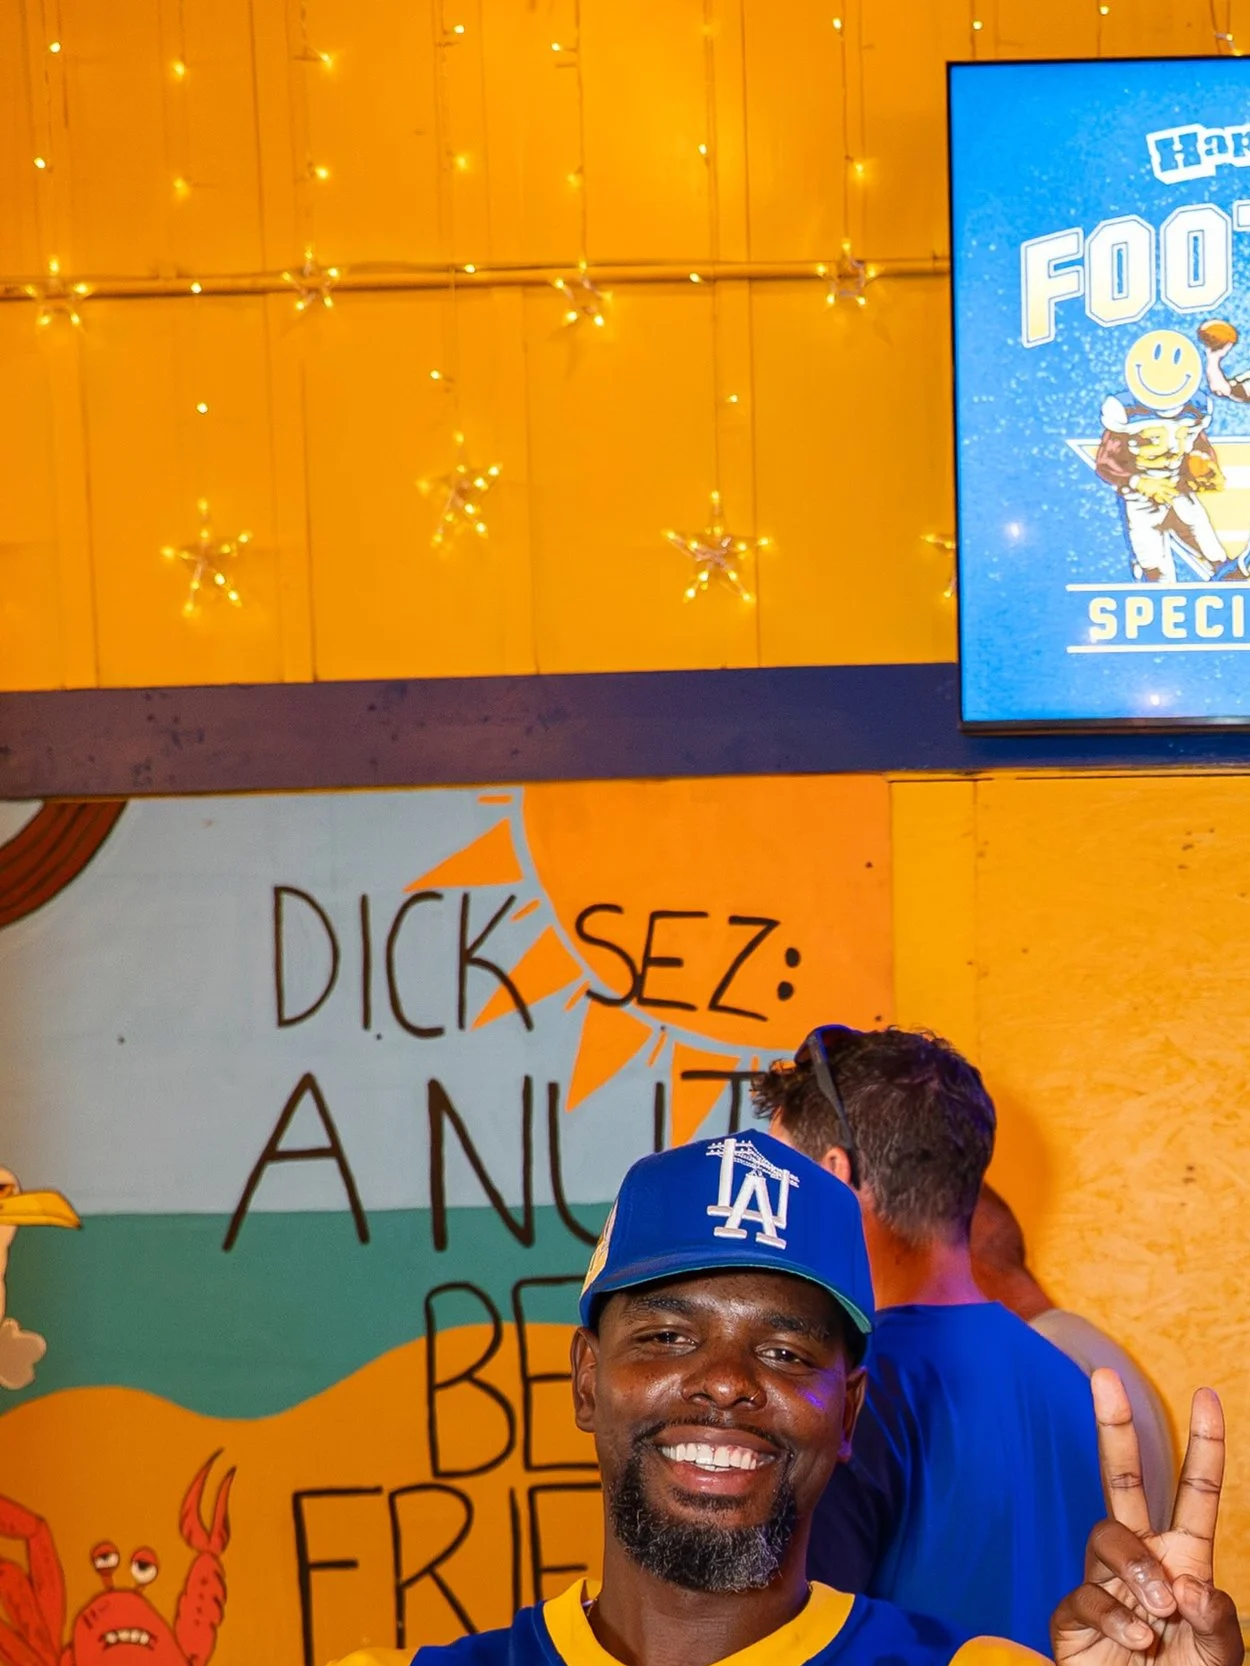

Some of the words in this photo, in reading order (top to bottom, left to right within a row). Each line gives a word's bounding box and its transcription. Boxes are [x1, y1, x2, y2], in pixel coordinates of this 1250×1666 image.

[272, 885, 535, 1038] DICK
[574, 902, 801, 1021] SEZ:
[221, 1072, 370, 1252] A
[706, 1138, 800, 1250] LA
